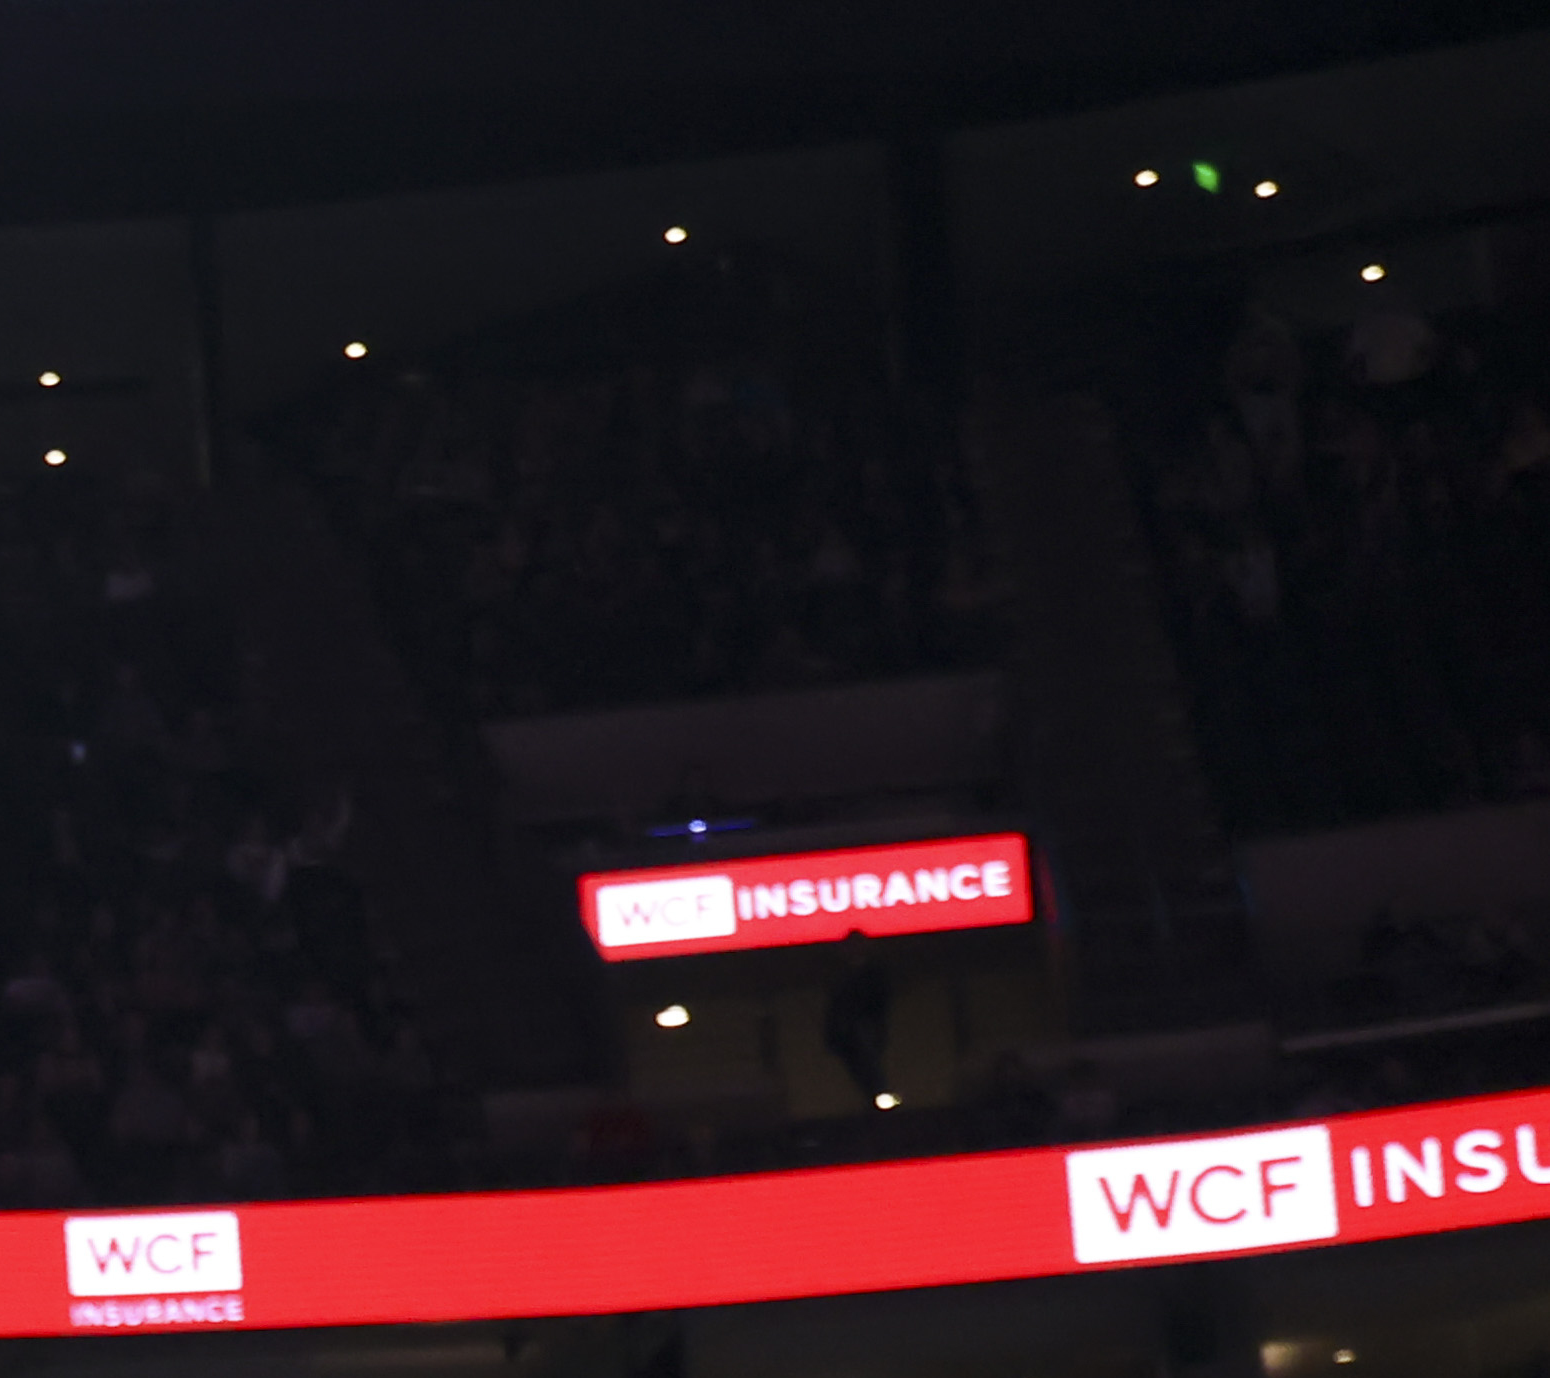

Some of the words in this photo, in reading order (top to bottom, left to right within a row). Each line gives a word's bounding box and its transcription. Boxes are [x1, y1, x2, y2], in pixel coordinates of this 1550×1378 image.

[736, 859, 1014, 921] INSURANCE
[1097, 1154, 1304, 1235] WCF
[86, 1231, 219, 1277] WCF
[69, 1296, 245, 1327] INSURANCE
